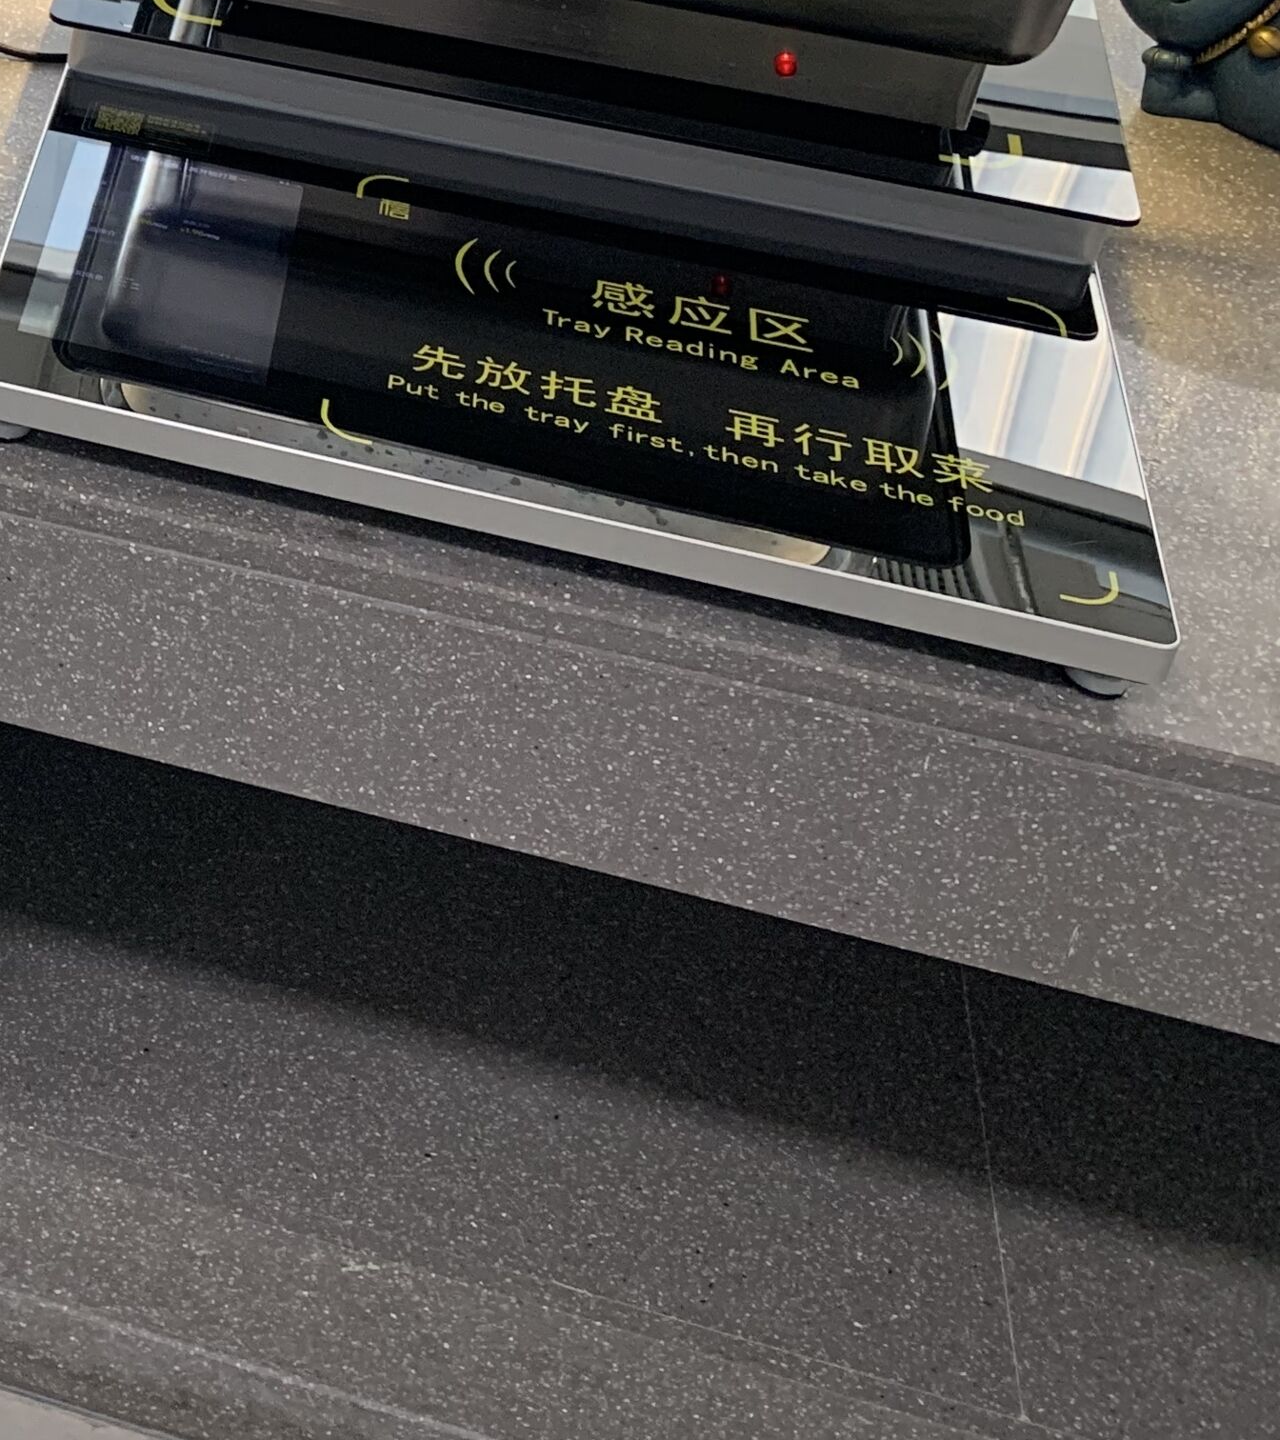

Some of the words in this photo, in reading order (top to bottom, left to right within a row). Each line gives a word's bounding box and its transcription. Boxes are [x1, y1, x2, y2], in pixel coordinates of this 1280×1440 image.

[541, 308, 613, 345] Tray
[625, 328, 759, 372] Reading
[779, 359, 860, 391] Area
[590, 279, 814, 354] 感应区
[387, 375, 440, 402] Put
[454, 390, 506, 415] the
[523, 402, 590, 436] tray
[794, 462, 869, 494] take
[878, 479, 935, 509] the
[945, 494, 1026, 529] food
[411, 343, 664, 425] 先放托盘
[725, 409, 994, 494] 再行取菜
